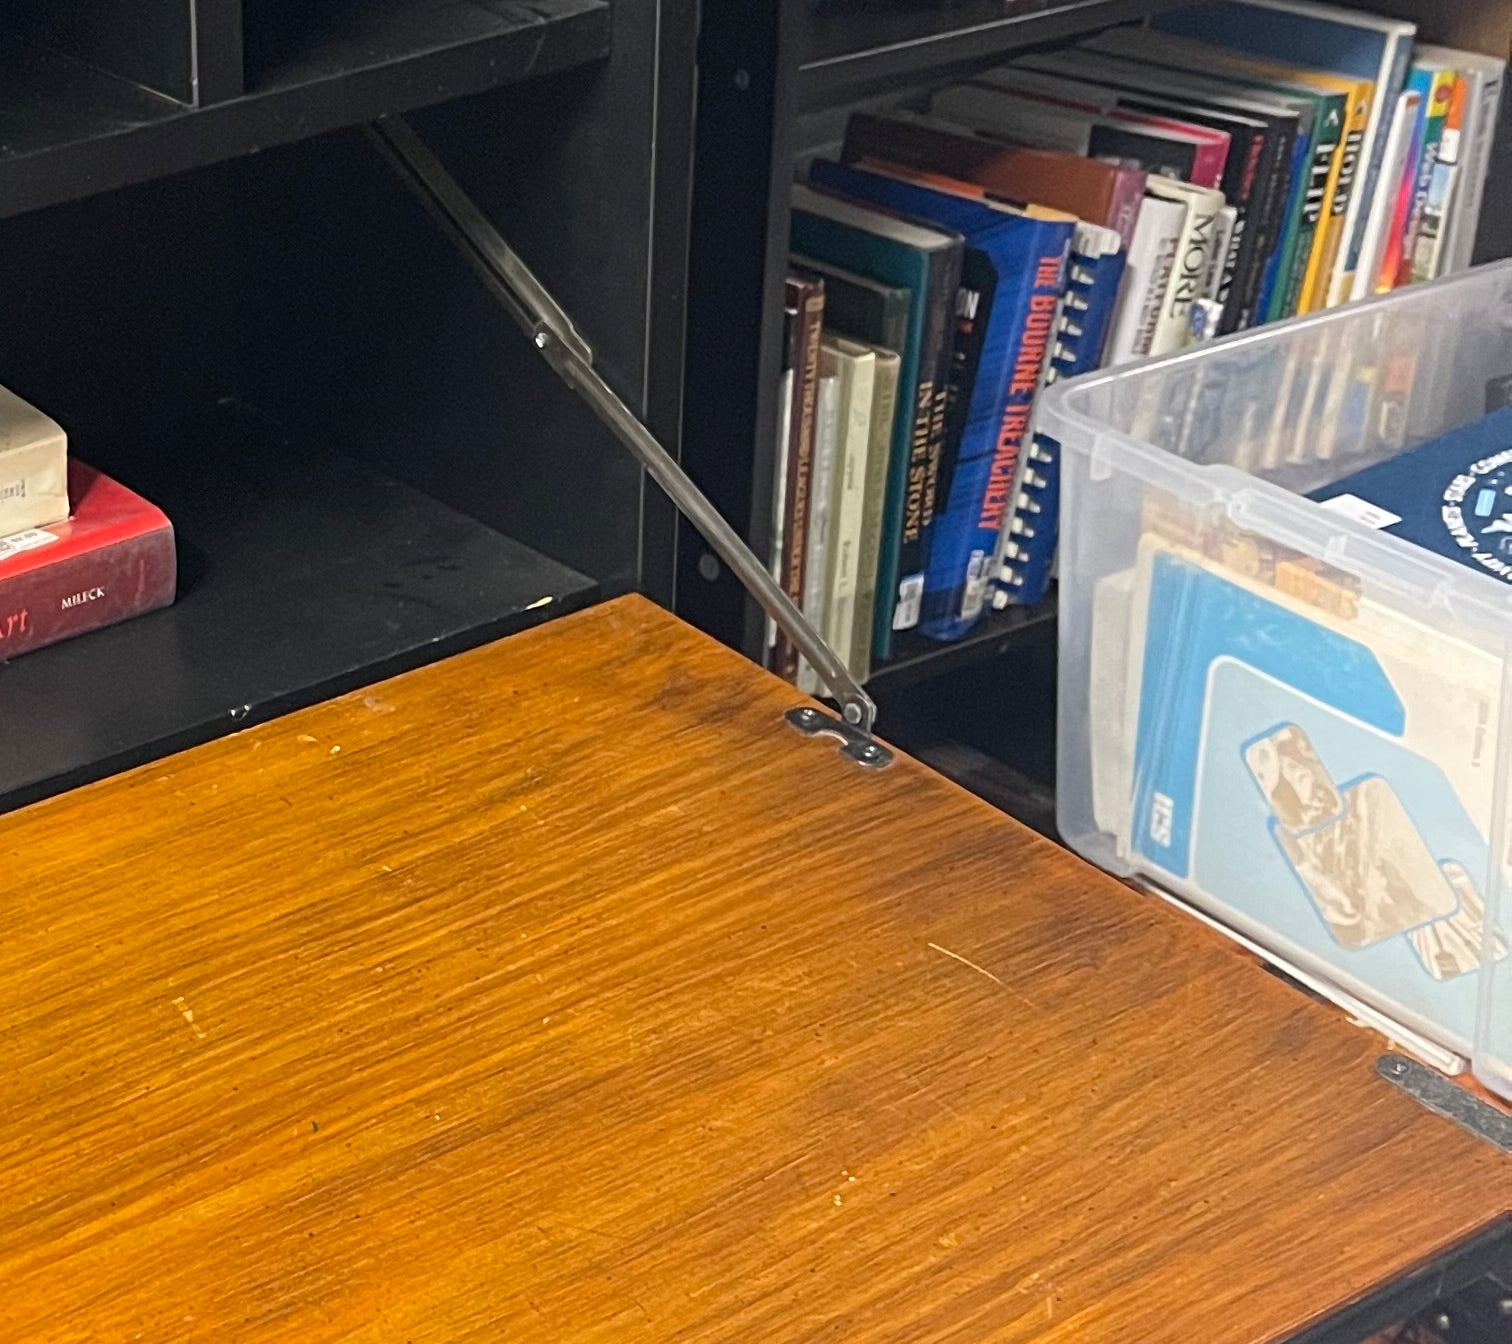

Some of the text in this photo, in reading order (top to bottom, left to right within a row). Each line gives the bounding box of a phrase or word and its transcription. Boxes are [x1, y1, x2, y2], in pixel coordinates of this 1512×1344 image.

[1170, 214, 1214, 319] MORE
[922, 391, 947, 526] THE SWORD
[978, 257, 1061, 530] THE BOURNE TREACHERY
[903, 381, 934, 544] IN THE STONE
[60, 586, 106, 610] MILECK
